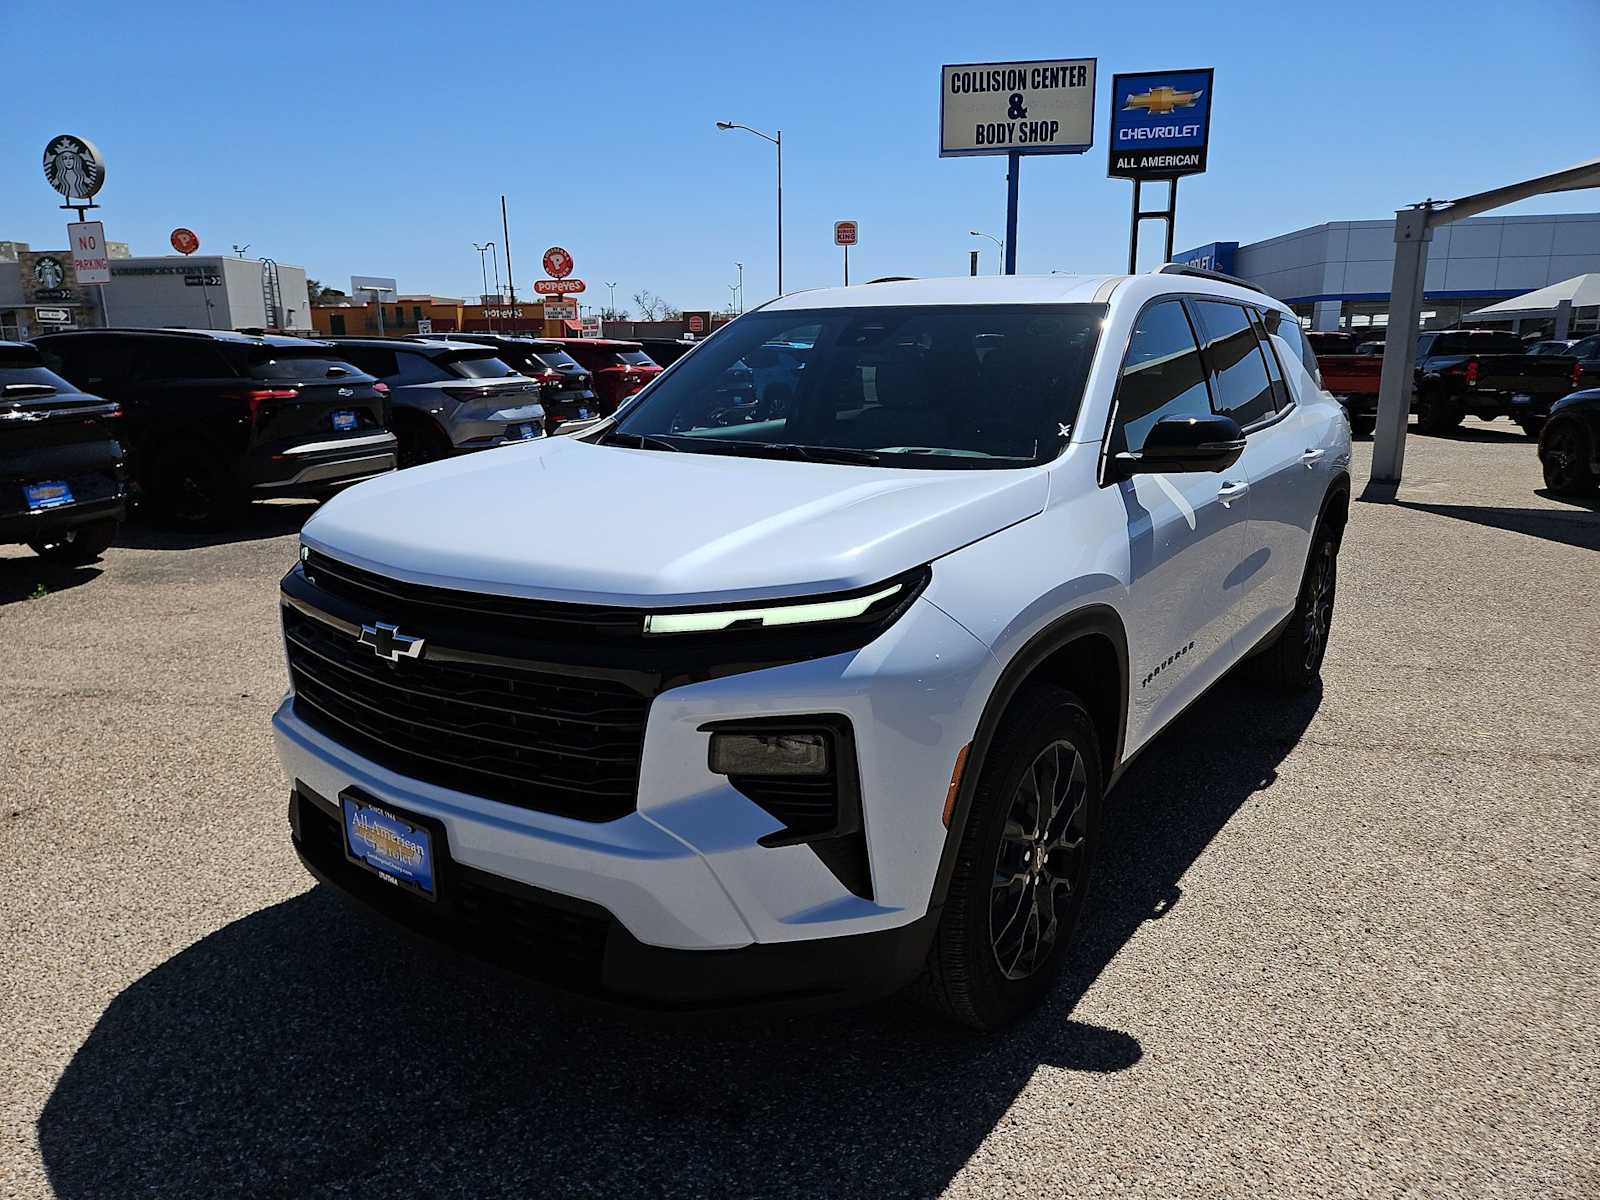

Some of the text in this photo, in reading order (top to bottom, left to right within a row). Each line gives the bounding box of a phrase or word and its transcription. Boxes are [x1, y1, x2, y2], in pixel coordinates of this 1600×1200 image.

[951, 65, 1087, 94] COLLISION CENTER
[1008, 93, 1028, 120] &
[976, 120, 1059, 145] BODY SHOP
[1119, 125, 1200, 140] CHEVROLET
[1117, 154, 1199, 169] ALL AMERICAN
[79, 236, 96, 250] NO
[73, 258, 107, 270] PARKING
[1141, 640, 1195, 688] TRAVERSE
[352, 811, 425, 857] All American
